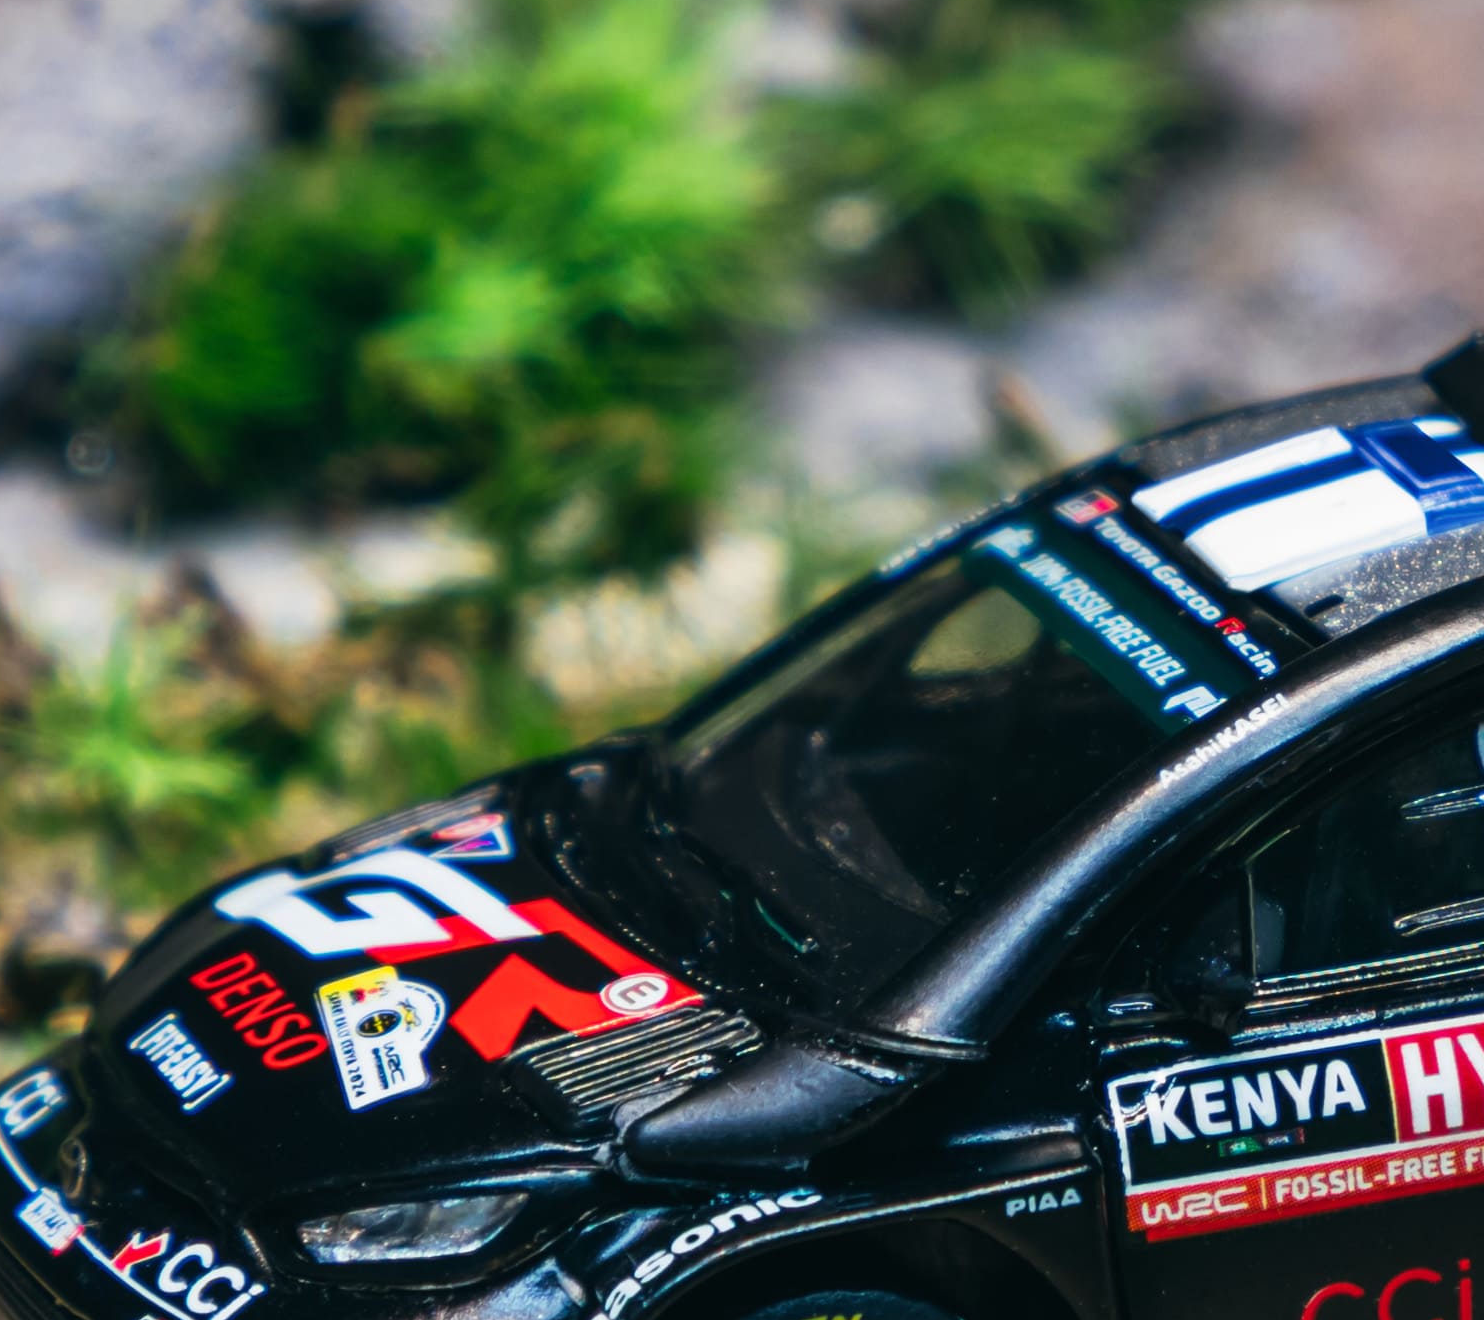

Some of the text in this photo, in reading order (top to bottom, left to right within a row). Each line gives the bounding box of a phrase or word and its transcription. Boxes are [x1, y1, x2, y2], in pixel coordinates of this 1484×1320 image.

[1053, 577, 1152, 658] FOSSIL-FREE
[1128, 641, 1187, 688] FUEL
[1094, 517, 1162, 570] TOYOTA
[1152, 565, 1221, 622] GAZOO
[1215, 617, 1277, 680] Racin
[1158, 693, 1292, 789] AsahiKASEI
[189, 952, 329, 1070] DENSO
[347, 1067, 367, 1098] 2024
[1145, 1059, 1368, 1145] KENYA
[1005, 1187, 1082, 1218] PIAA
[1141, 1184, 1250, 1225] WRC
[1274, 1150, 1457, 1204] FOSSIL-FREE
